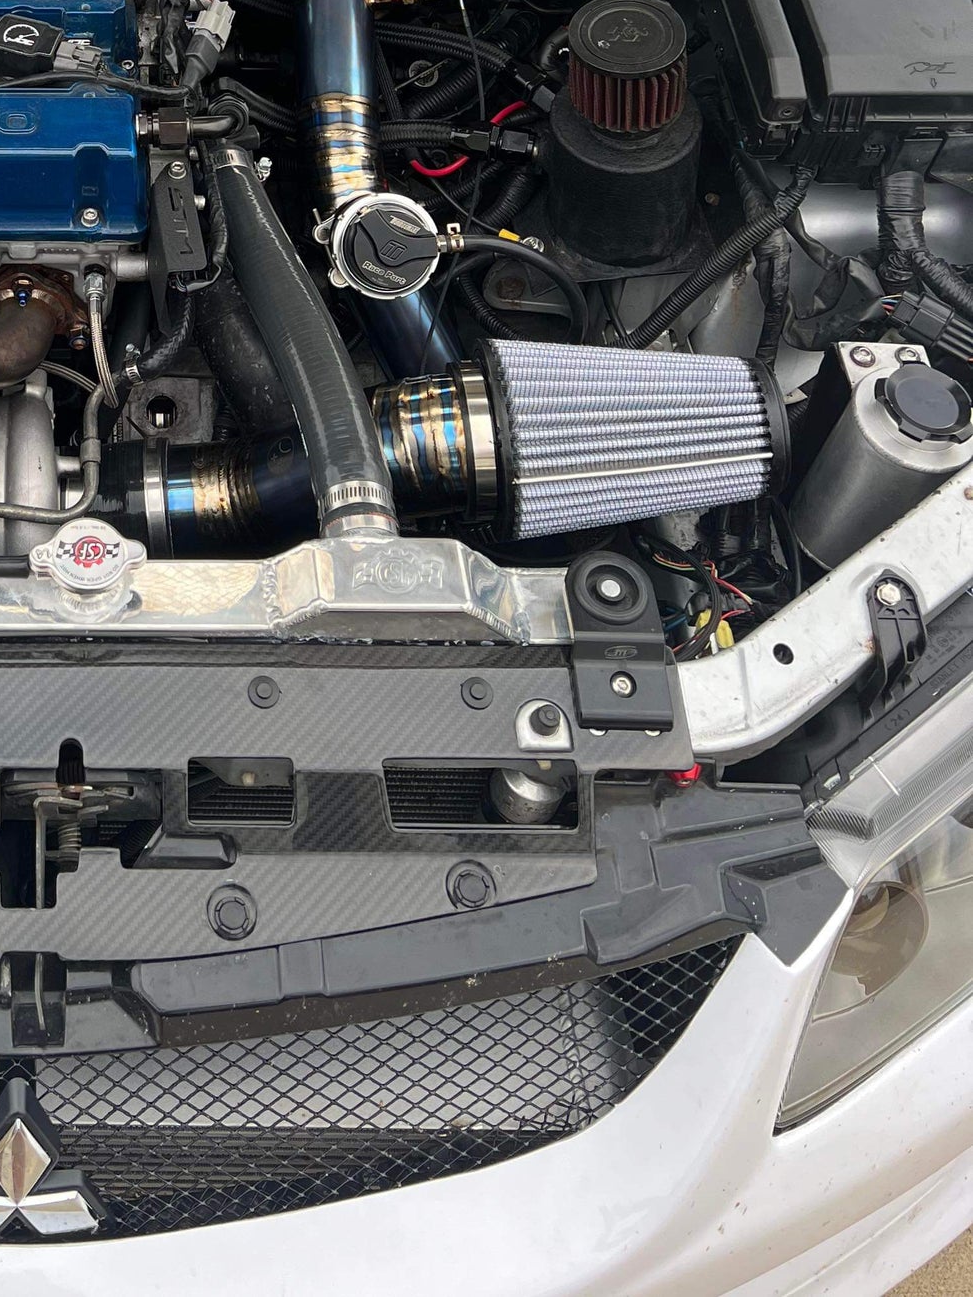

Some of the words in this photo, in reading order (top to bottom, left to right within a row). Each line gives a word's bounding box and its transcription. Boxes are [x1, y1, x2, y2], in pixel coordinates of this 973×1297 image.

[362, 261, 385, 276] Race
[385, 270, 407, 285] Part
[79, 542, 104, 561] CSF
